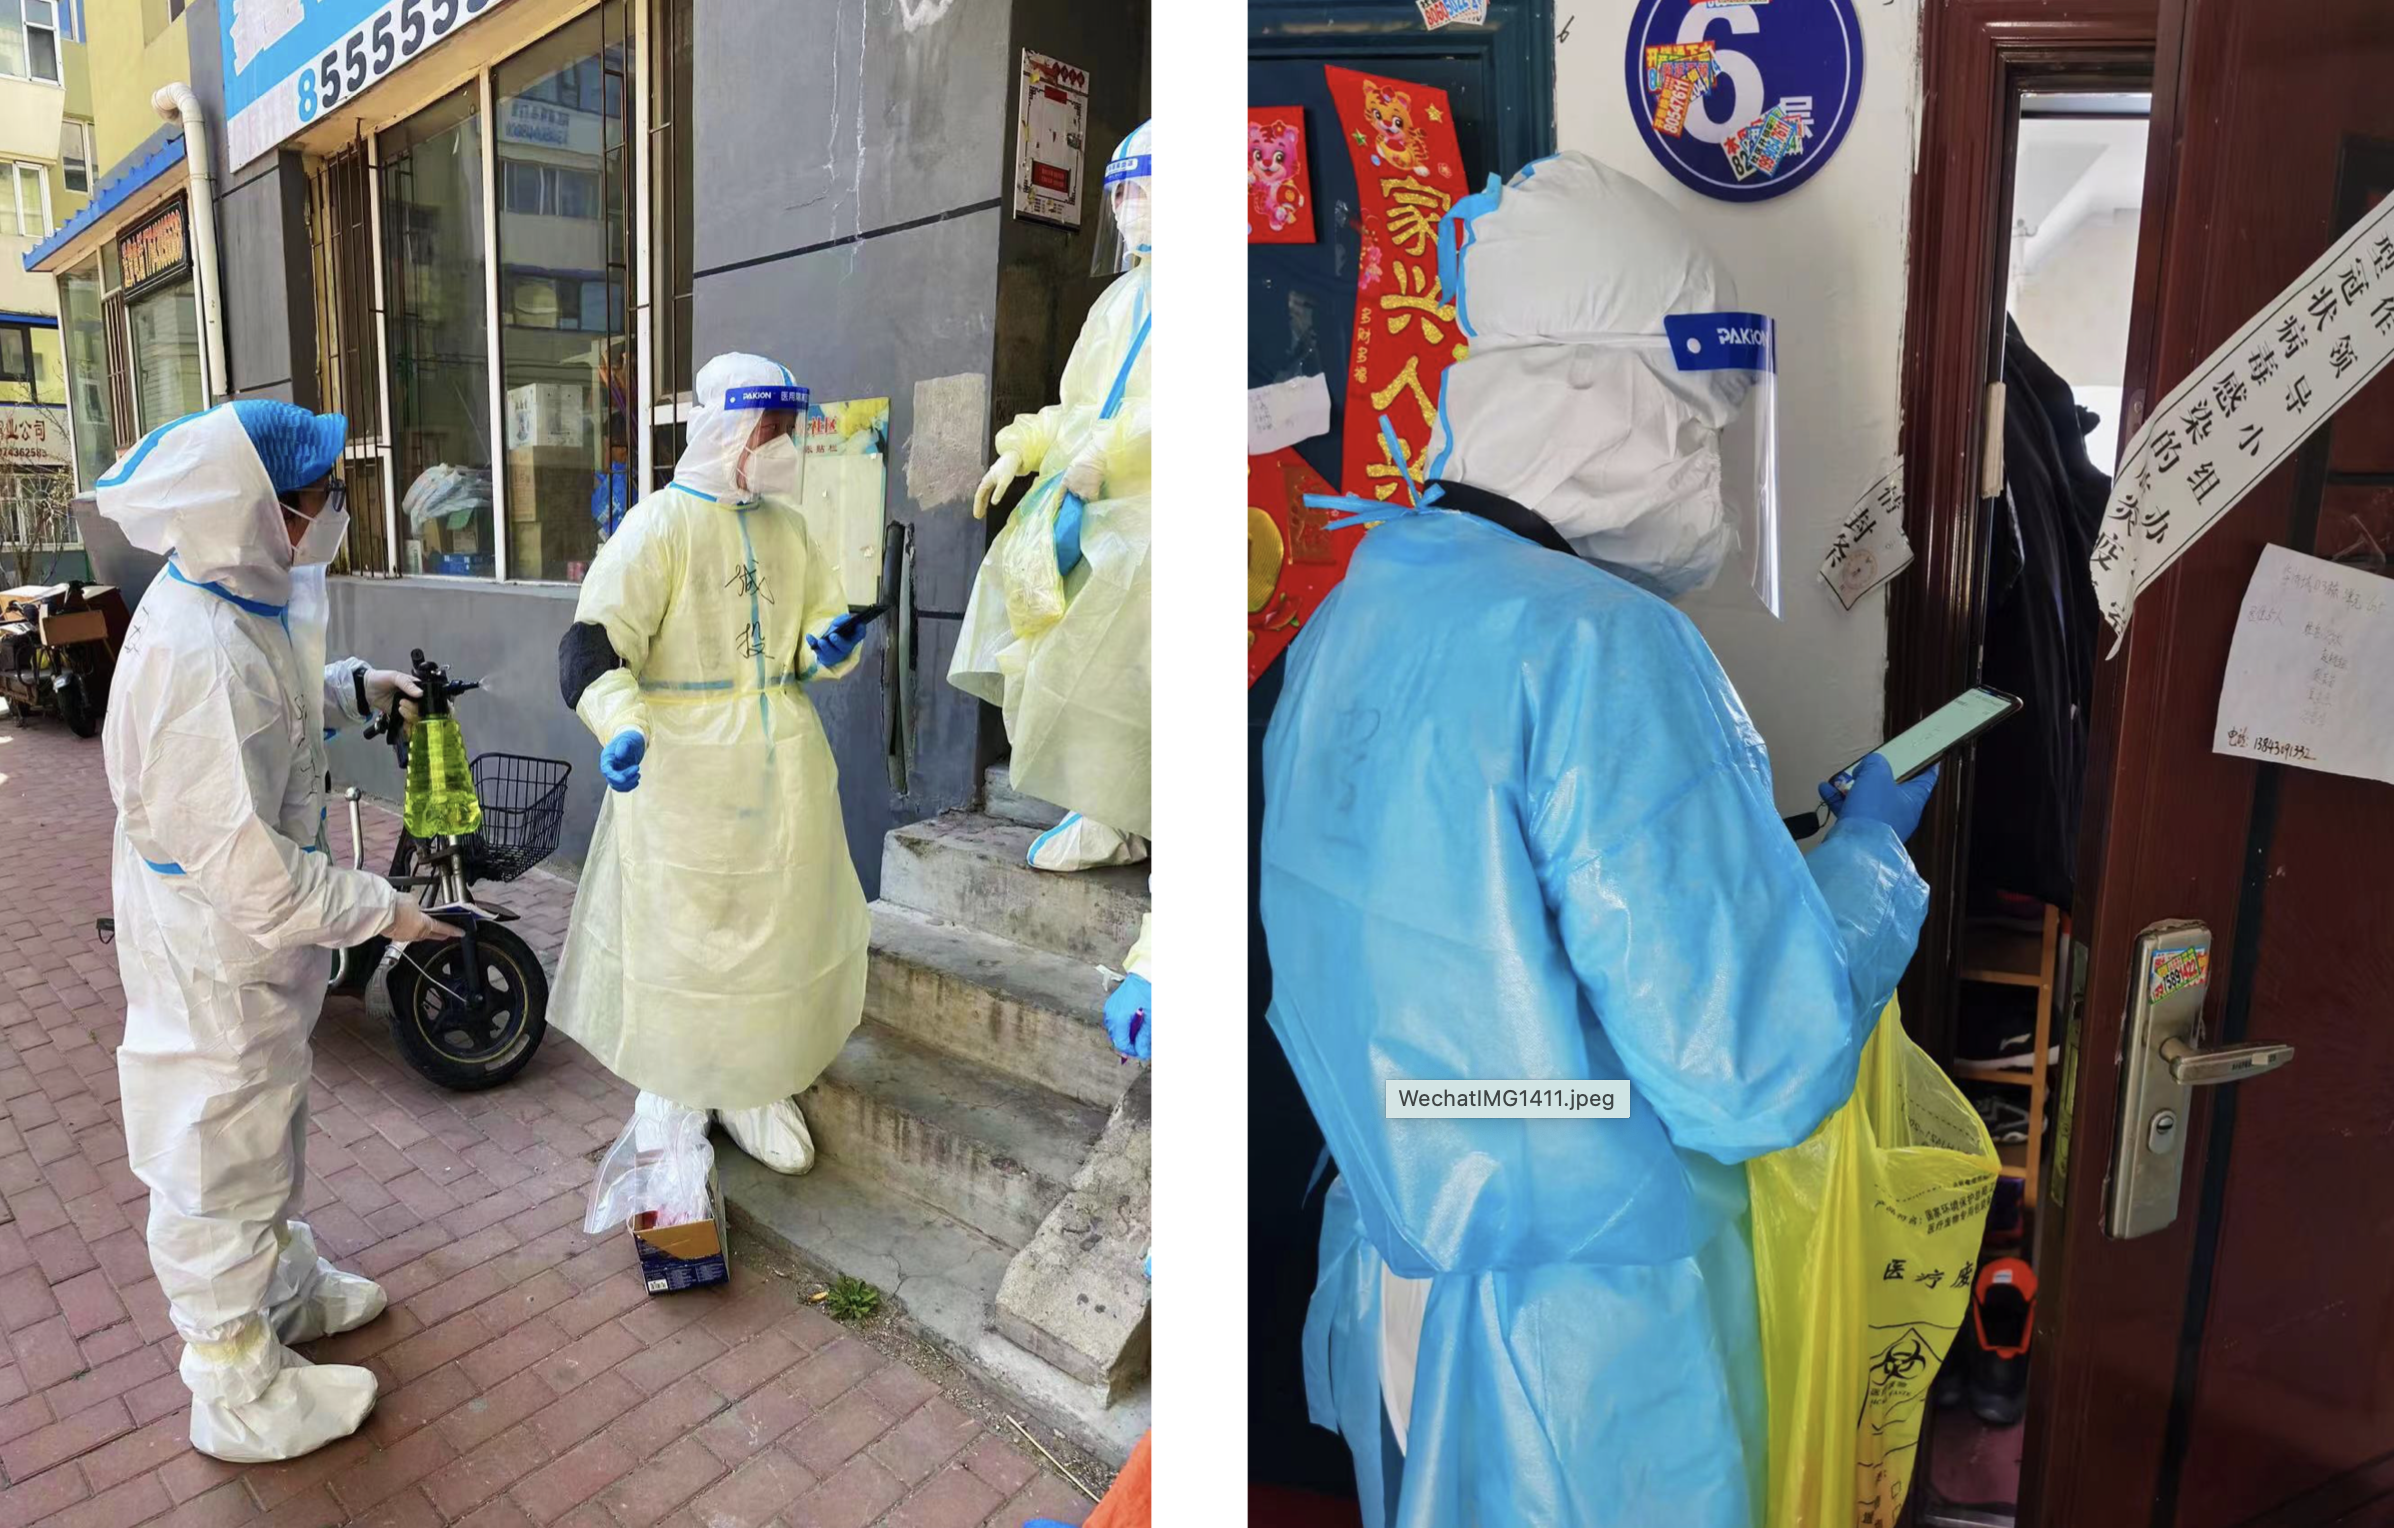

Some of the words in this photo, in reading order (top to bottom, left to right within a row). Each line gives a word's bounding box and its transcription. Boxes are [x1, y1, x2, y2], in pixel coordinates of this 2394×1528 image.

[297, 0, 491, 122] 855555
[1663, 78, 1690, 134] 80547611
[1364, 175, 1456, 529] 家兴人兴
[0, 418, 45, 442] 业公司
[807, 416, 838, 436] 社区
[2107, 296, 2394, 636] 作领导小组办室
